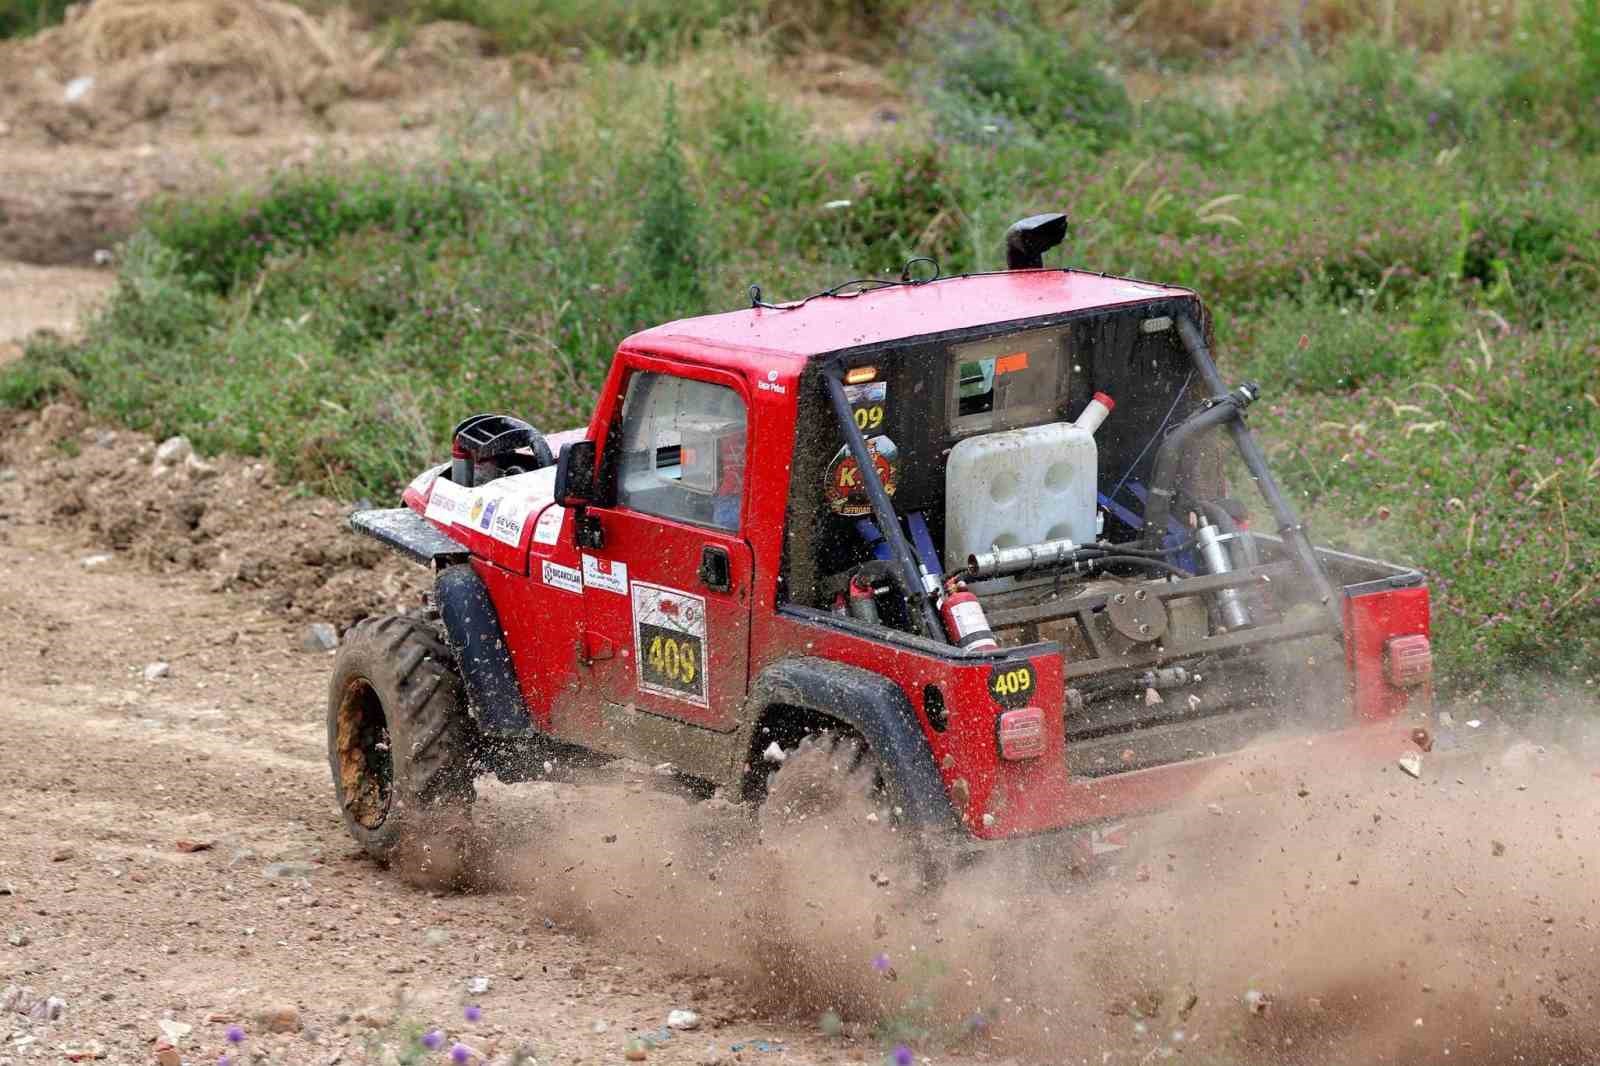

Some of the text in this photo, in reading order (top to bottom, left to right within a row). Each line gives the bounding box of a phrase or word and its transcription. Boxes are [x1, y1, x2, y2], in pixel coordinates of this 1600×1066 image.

[855, 405, 883, 430] 09
[649, 635, 695, 684] 409
[995, 668, 1030, 695] 409
